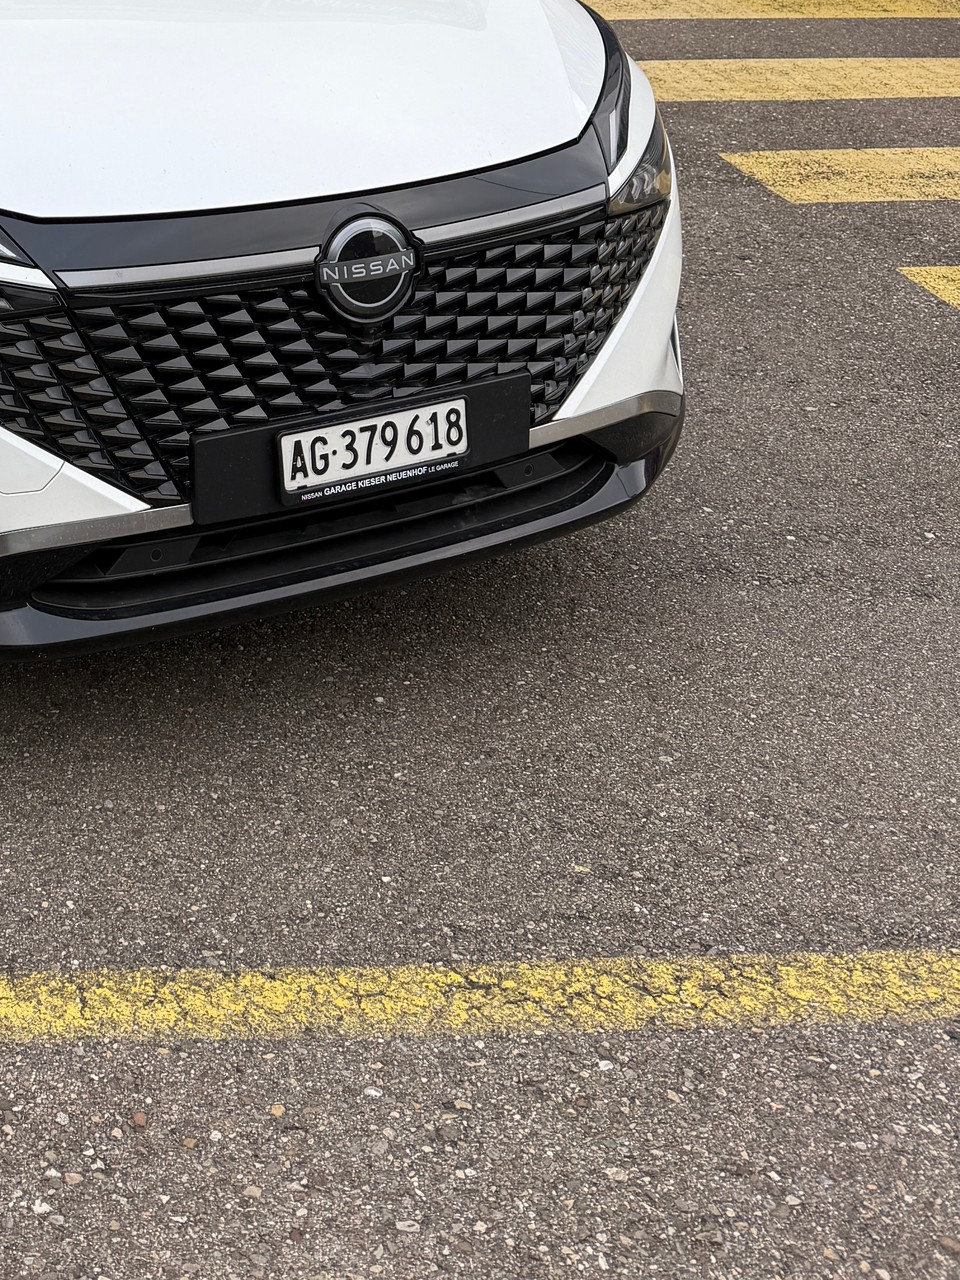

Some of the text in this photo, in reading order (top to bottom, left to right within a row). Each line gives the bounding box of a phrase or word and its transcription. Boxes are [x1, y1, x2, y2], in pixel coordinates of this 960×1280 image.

[322, 253, 414, 280] NISSAN
[301, 460, 459, 501] NISSAN GARAGE KIESER NEUENHOF LE GARAGE
